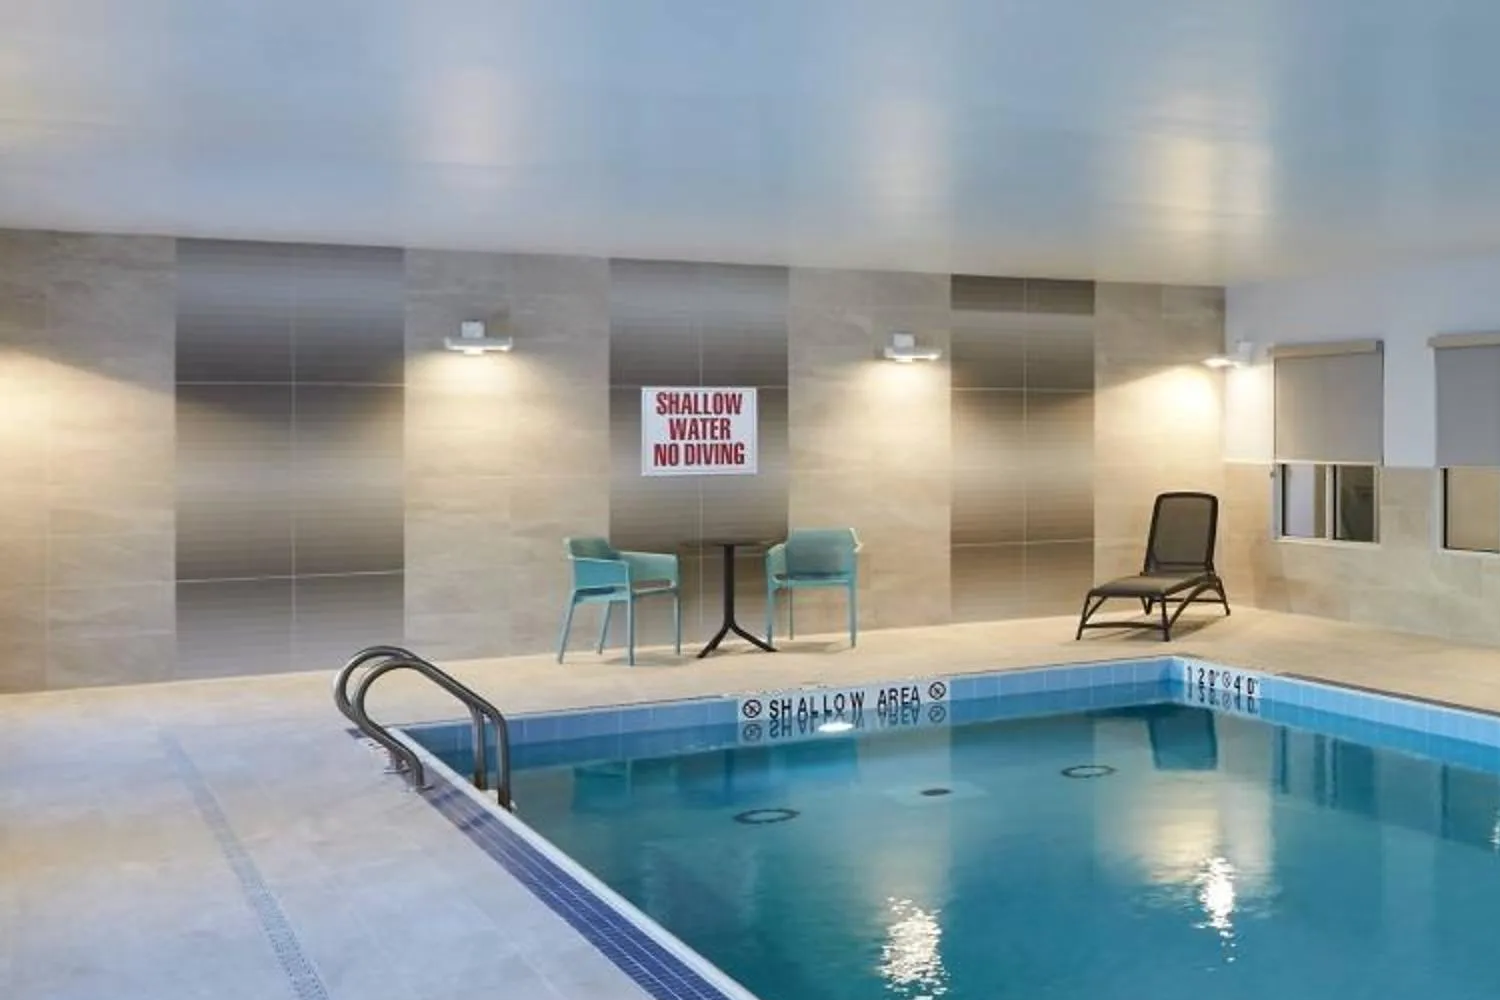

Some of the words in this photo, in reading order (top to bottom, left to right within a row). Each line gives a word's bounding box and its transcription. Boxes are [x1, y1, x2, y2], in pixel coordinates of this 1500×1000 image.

[656, 391, 743, 415] SHALLOW
[669, 417, 731, 440] WATER
[653, 444, 679, 466] NO
[684, 443, 745, 465] DIVING
[769, 692, 865, 721] SHALLOW
[877, 686, 921, 711] AREA
